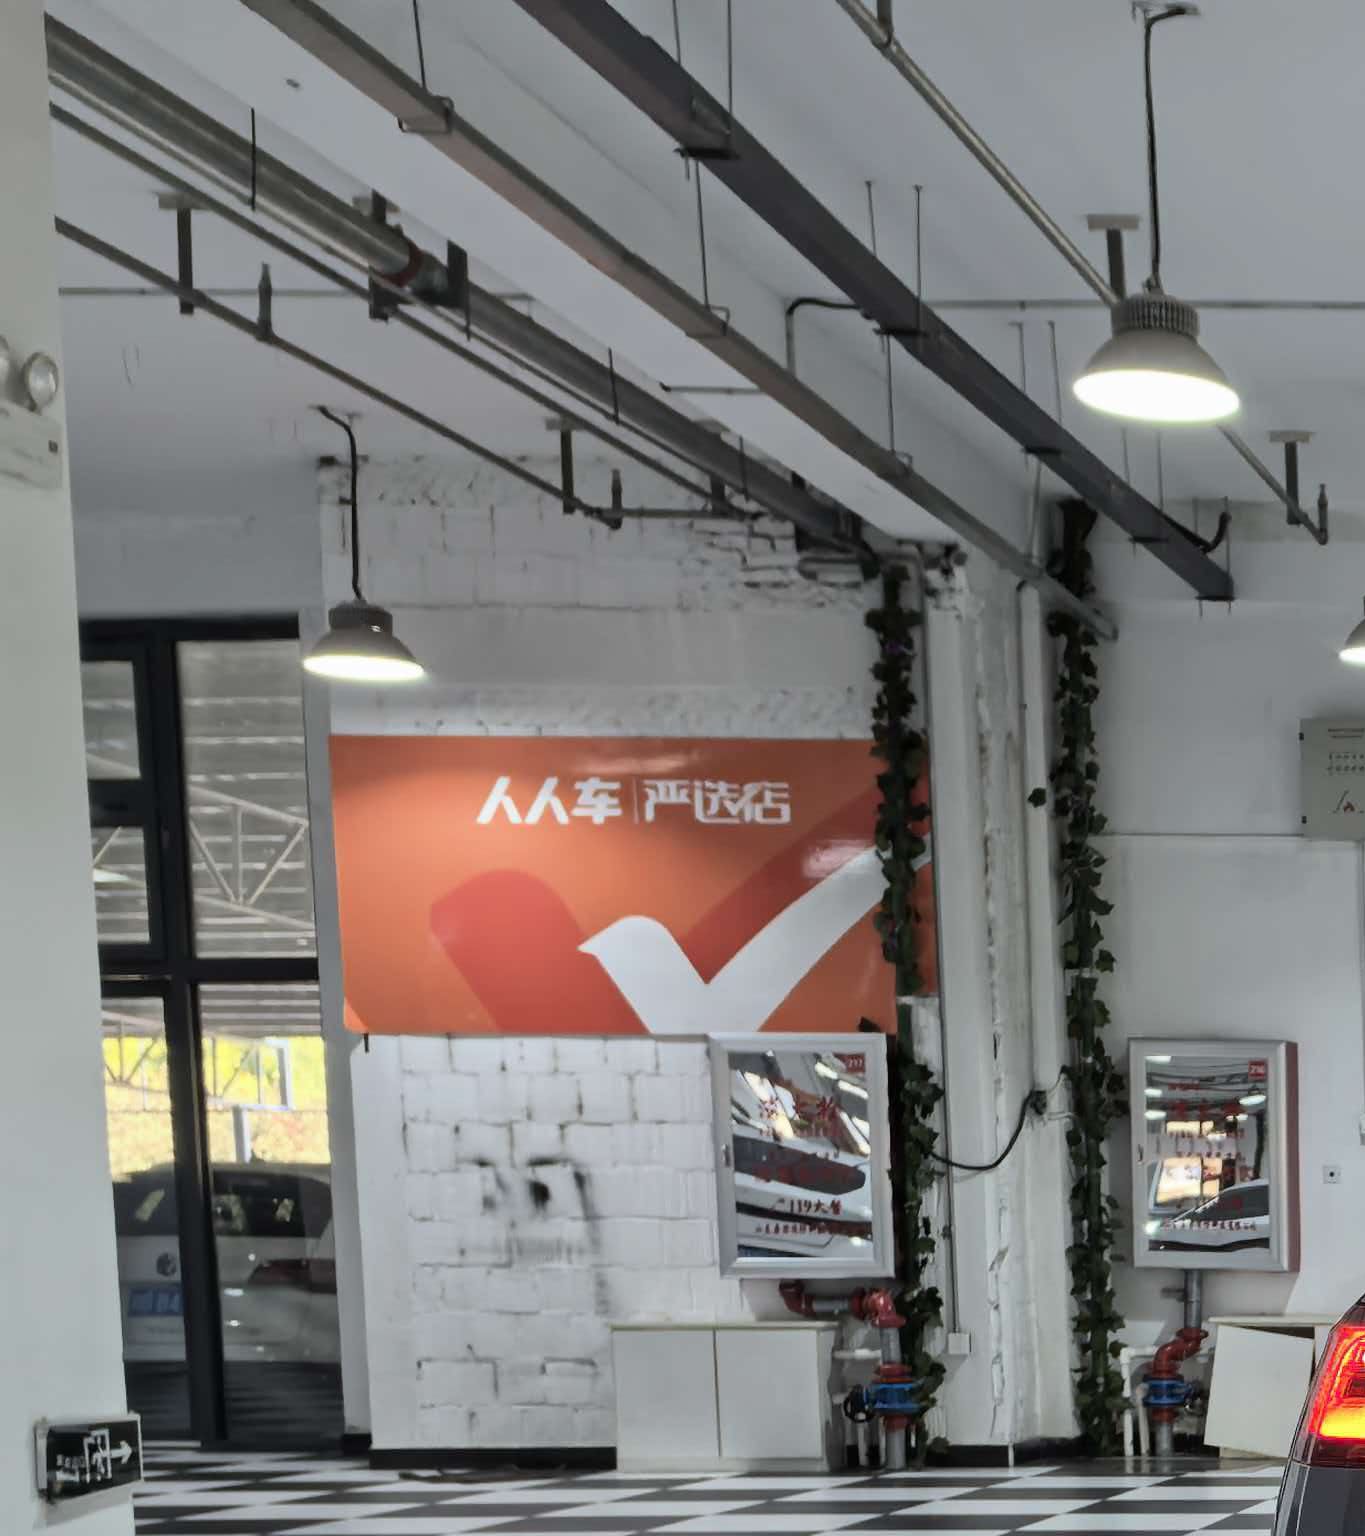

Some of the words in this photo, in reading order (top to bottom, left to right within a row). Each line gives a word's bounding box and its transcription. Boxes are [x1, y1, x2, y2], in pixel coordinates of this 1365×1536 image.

[475, 775, 623, 825] 人人车
[642, 778, 791, 824] 严选店
